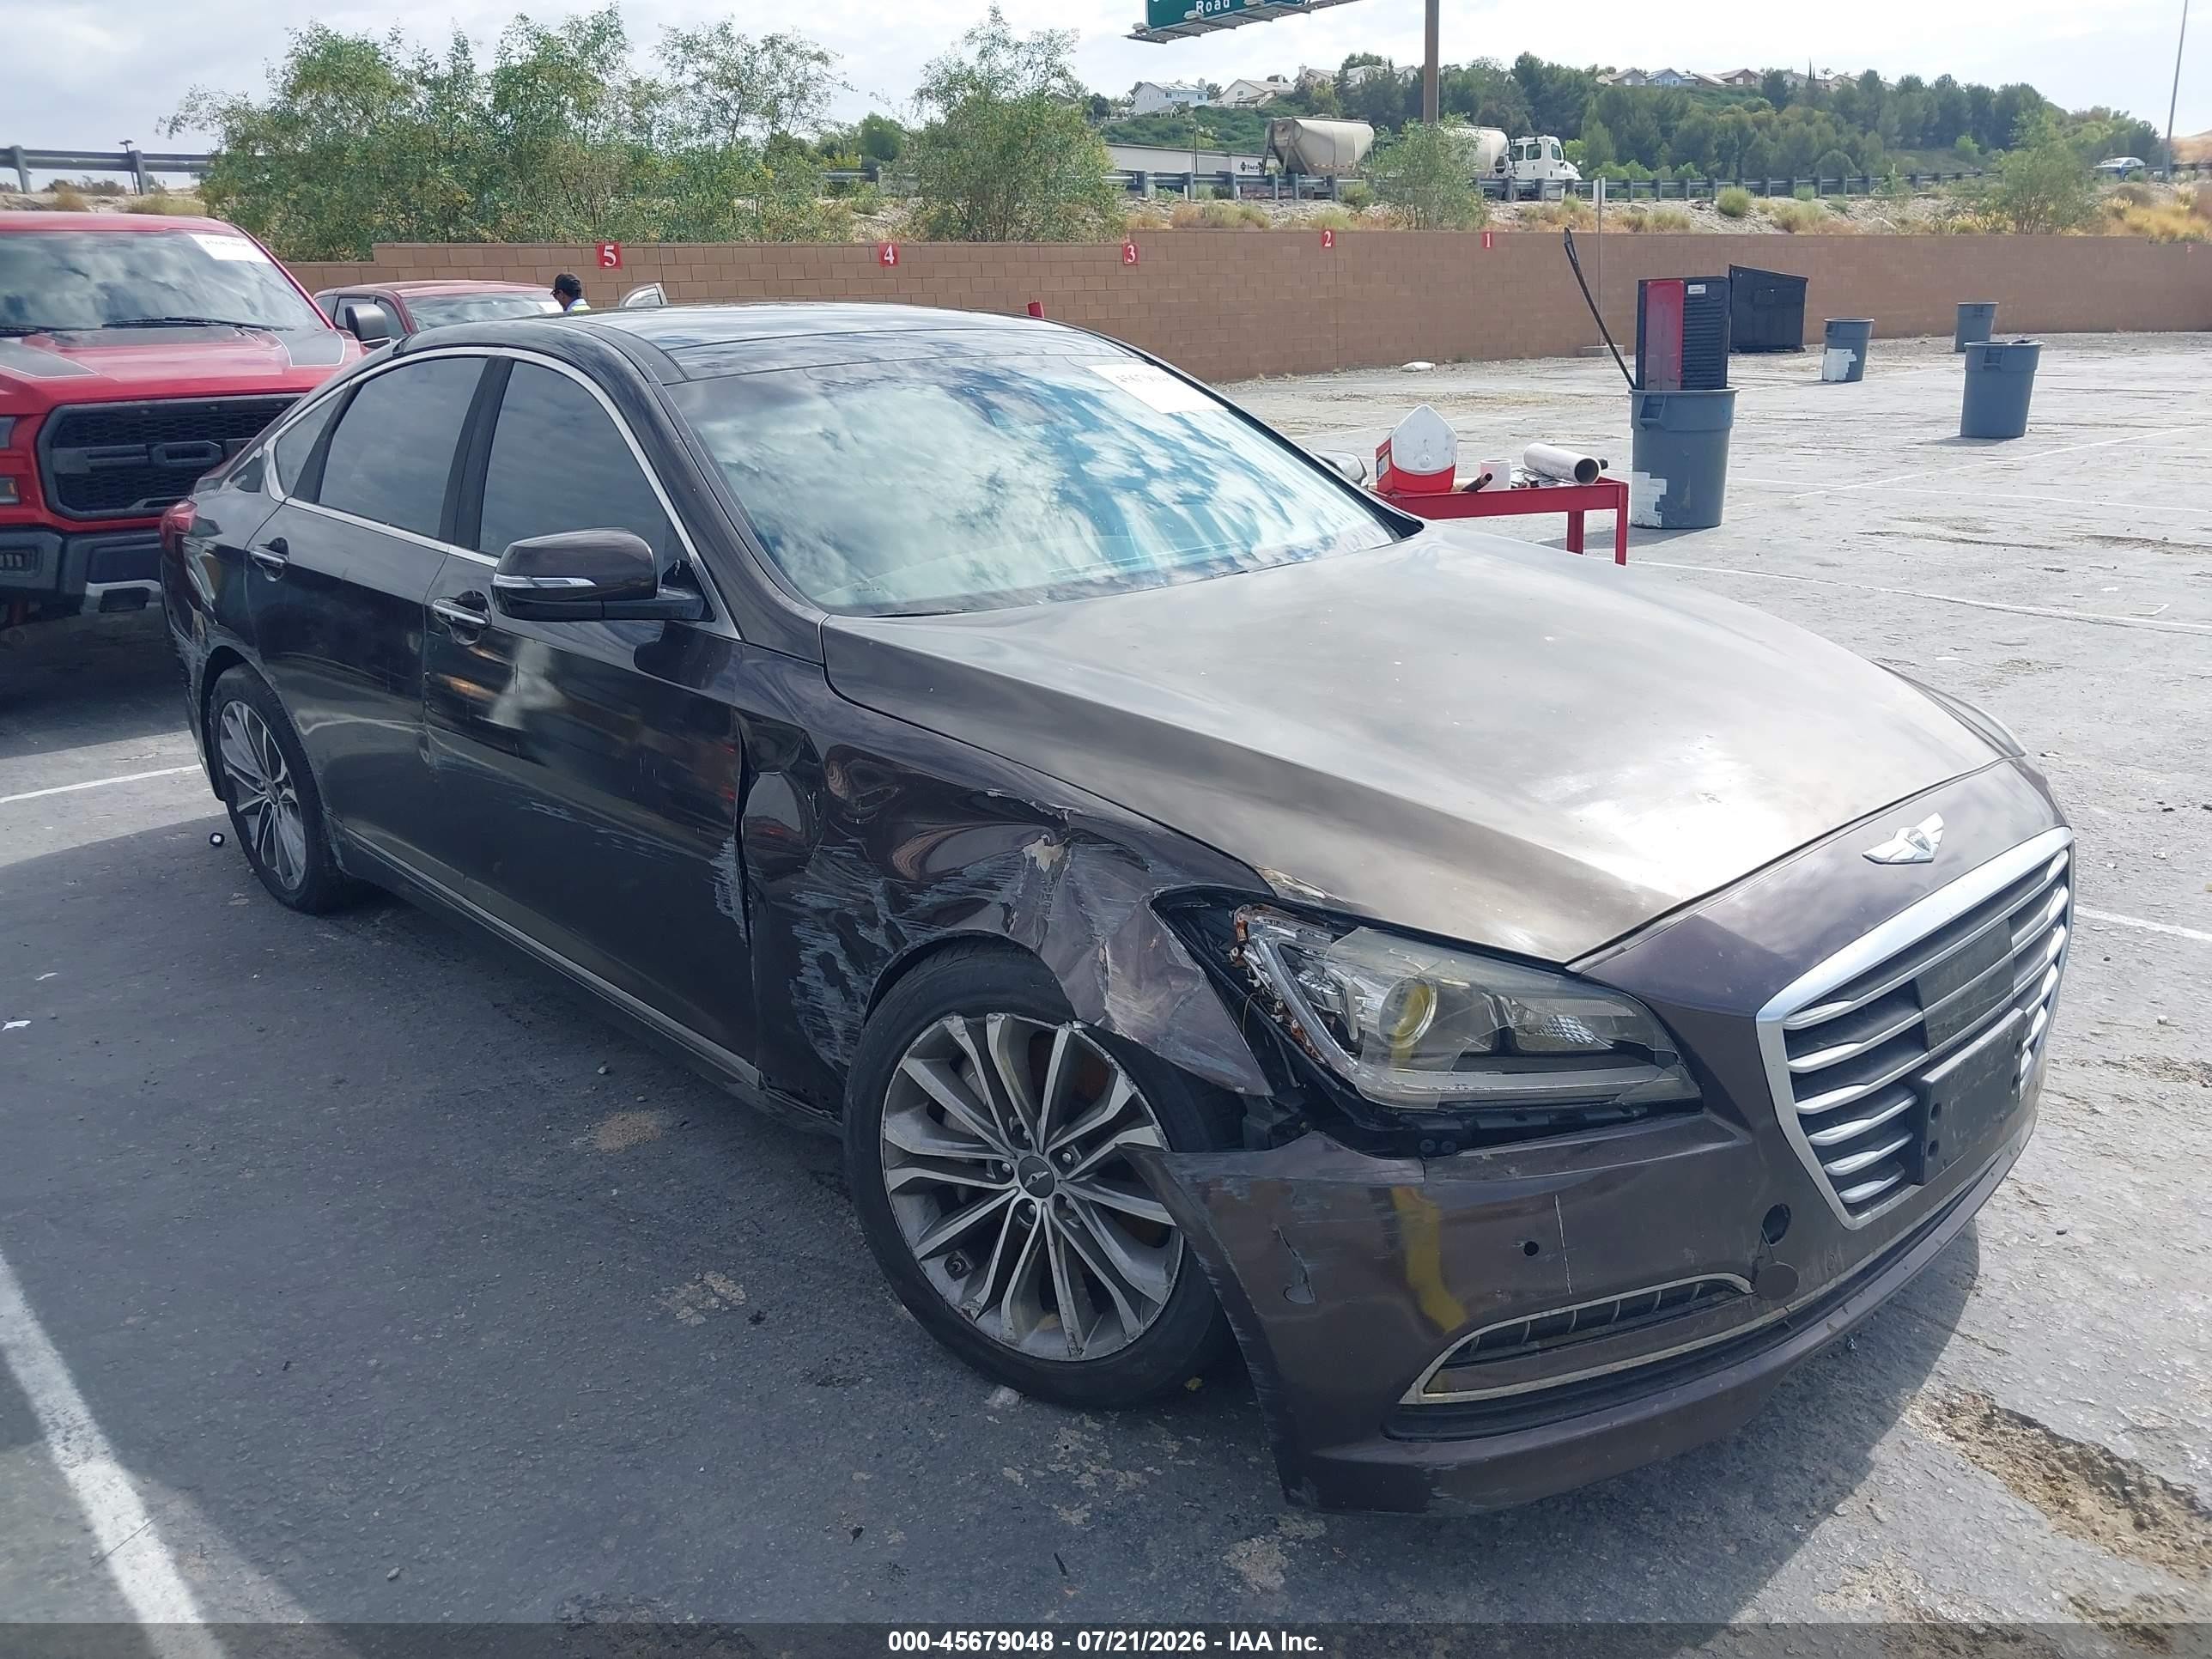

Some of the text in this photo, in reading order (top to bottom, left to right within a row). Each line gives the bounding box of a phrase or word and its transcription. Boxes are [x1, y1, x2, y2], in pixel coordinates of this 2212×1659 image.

[1195, 0, 1231, 14] Road
[1324, 230, 1332, 247] 2
[1485, 233, 1491, 248] 1
[604, 245, 617, 267] 5
[884, 244, 894, 264] 4
[1127, 244, 1135, 263] 3
